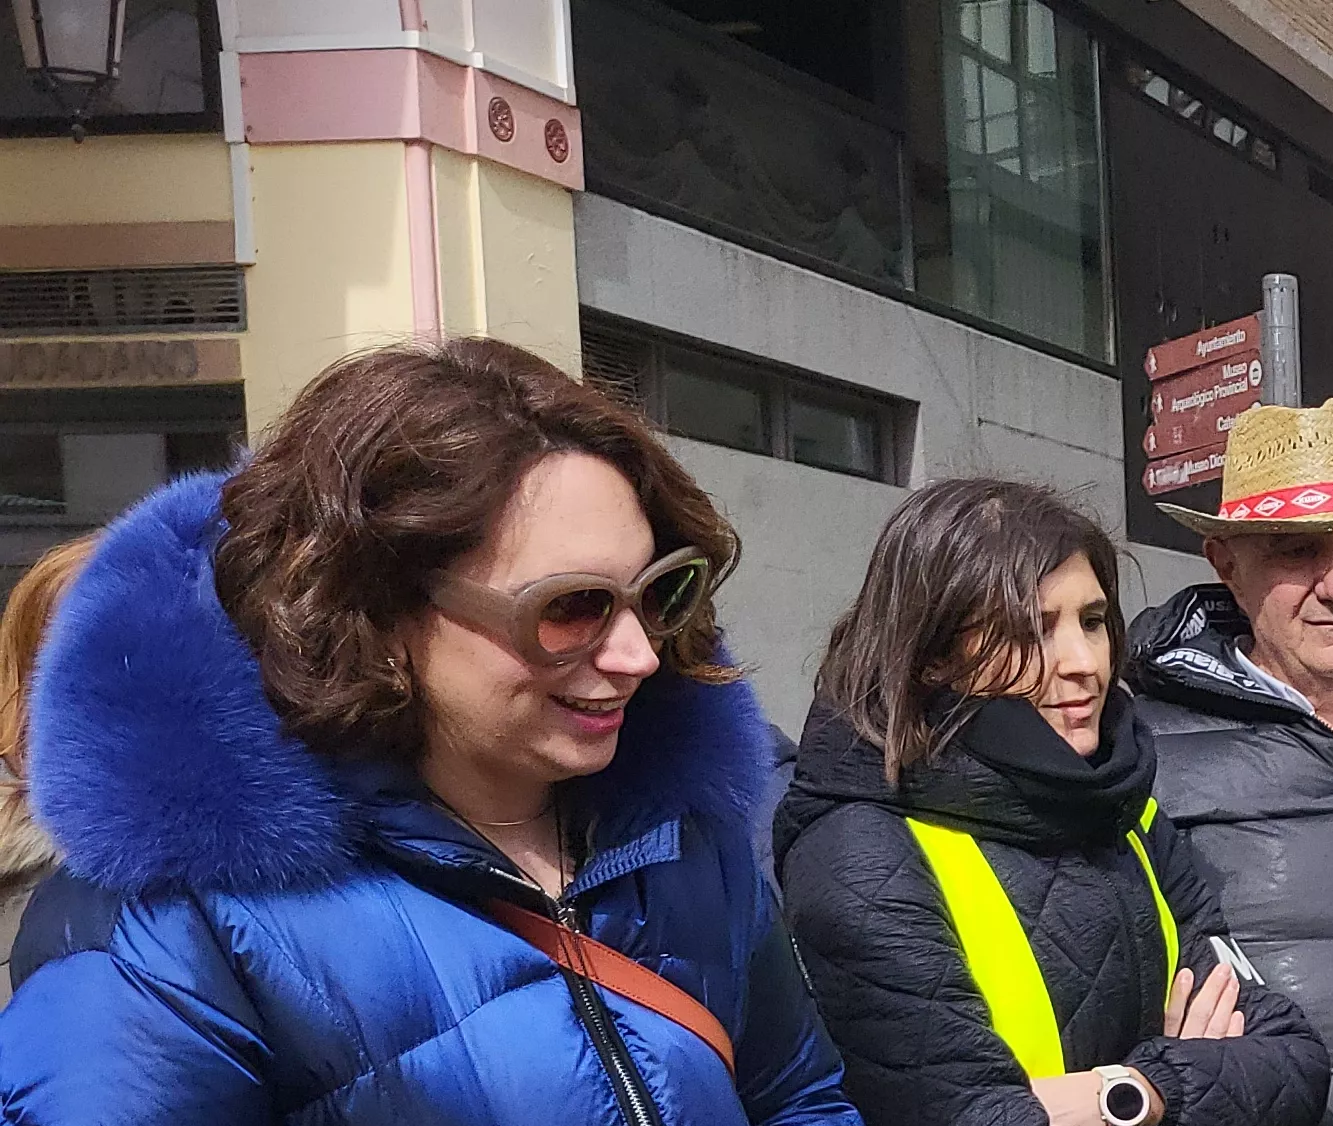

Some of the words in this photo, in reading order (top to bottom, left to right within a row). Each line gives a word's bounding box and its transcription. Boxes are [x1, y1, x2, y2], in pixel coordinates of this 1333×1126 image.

[1196, 329, 1247, 358] Ayuntamiento
[1222, 362, 1248, 380] Museo
[1214, 377, 1248, 402] Provincial
